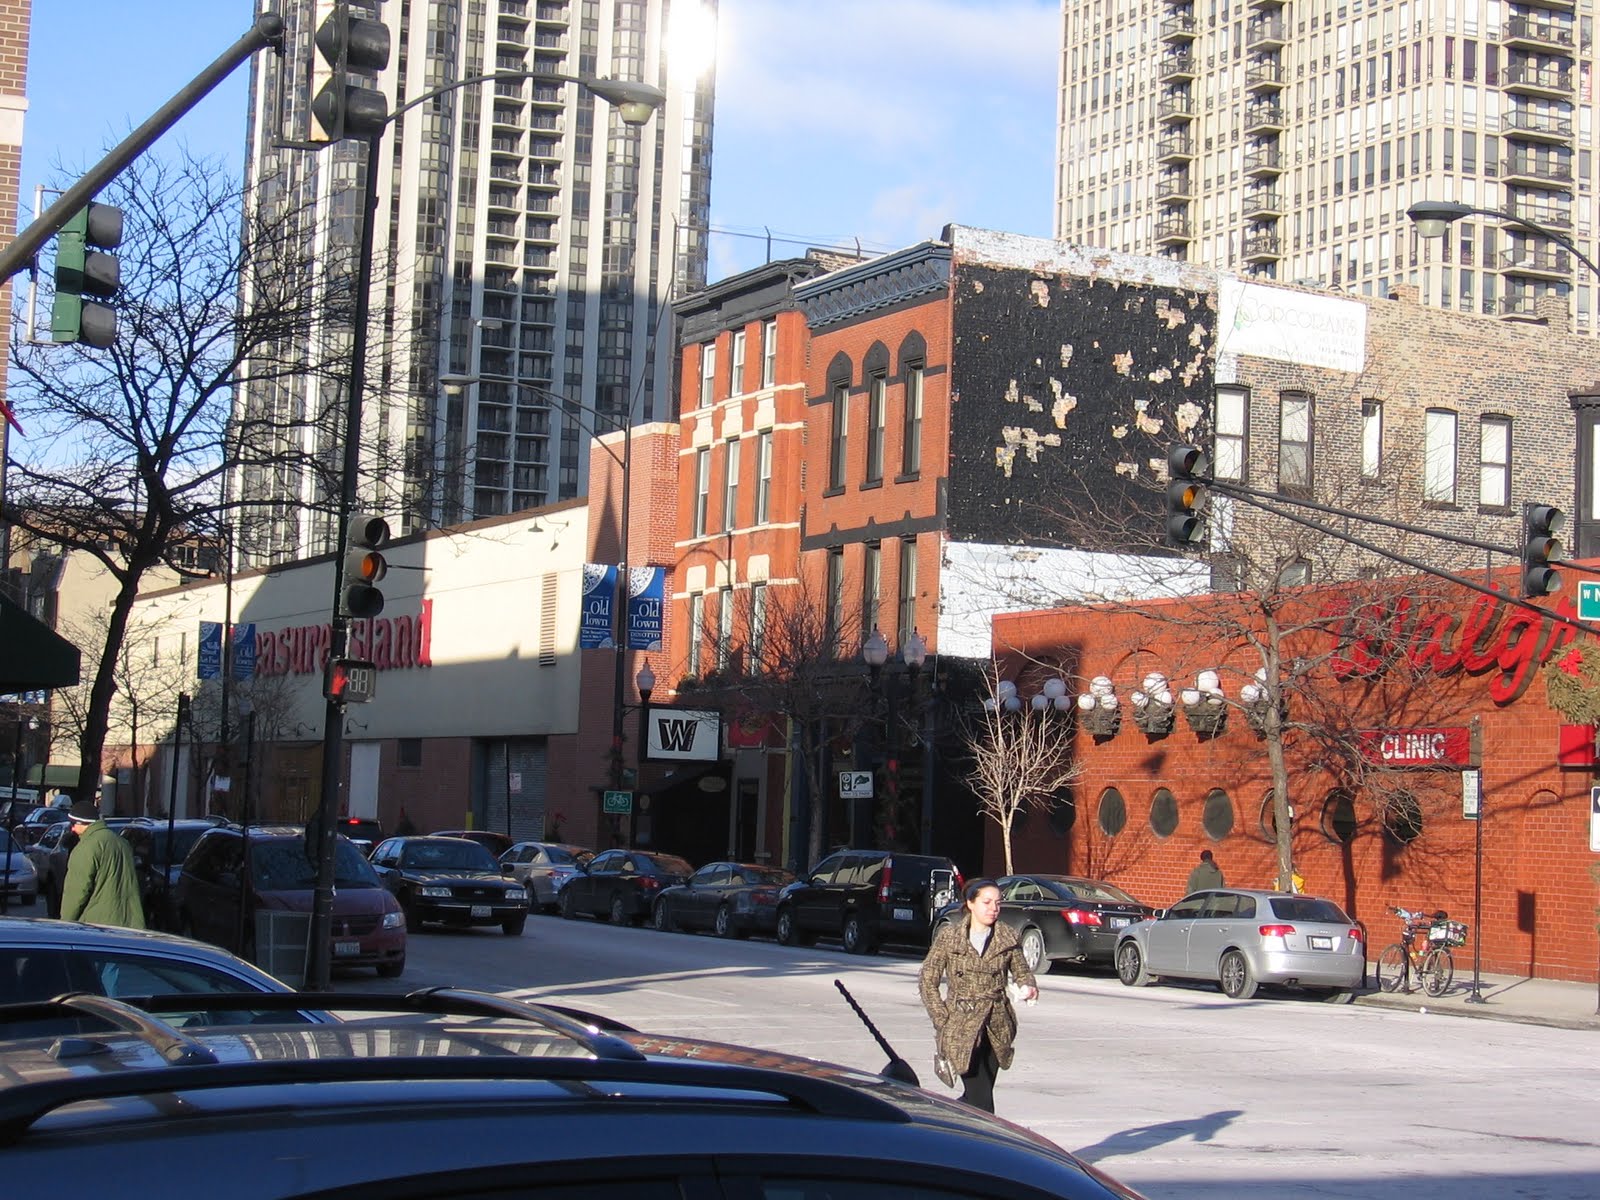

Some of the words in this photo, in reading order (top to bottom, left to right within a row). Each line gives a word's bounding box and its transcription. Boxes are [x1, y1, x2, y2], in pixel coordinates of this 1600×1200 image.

[1583, 589, 1591, 599] W
[590, 600, 609, 615] Old
[638, 602, 660, 617] Old
[583, 610, 608, 626] Town
[630, 614, 659, 629] Town
[658, 719, 698, 752] W
[1381, 733, 1446, 759] CLINIC
